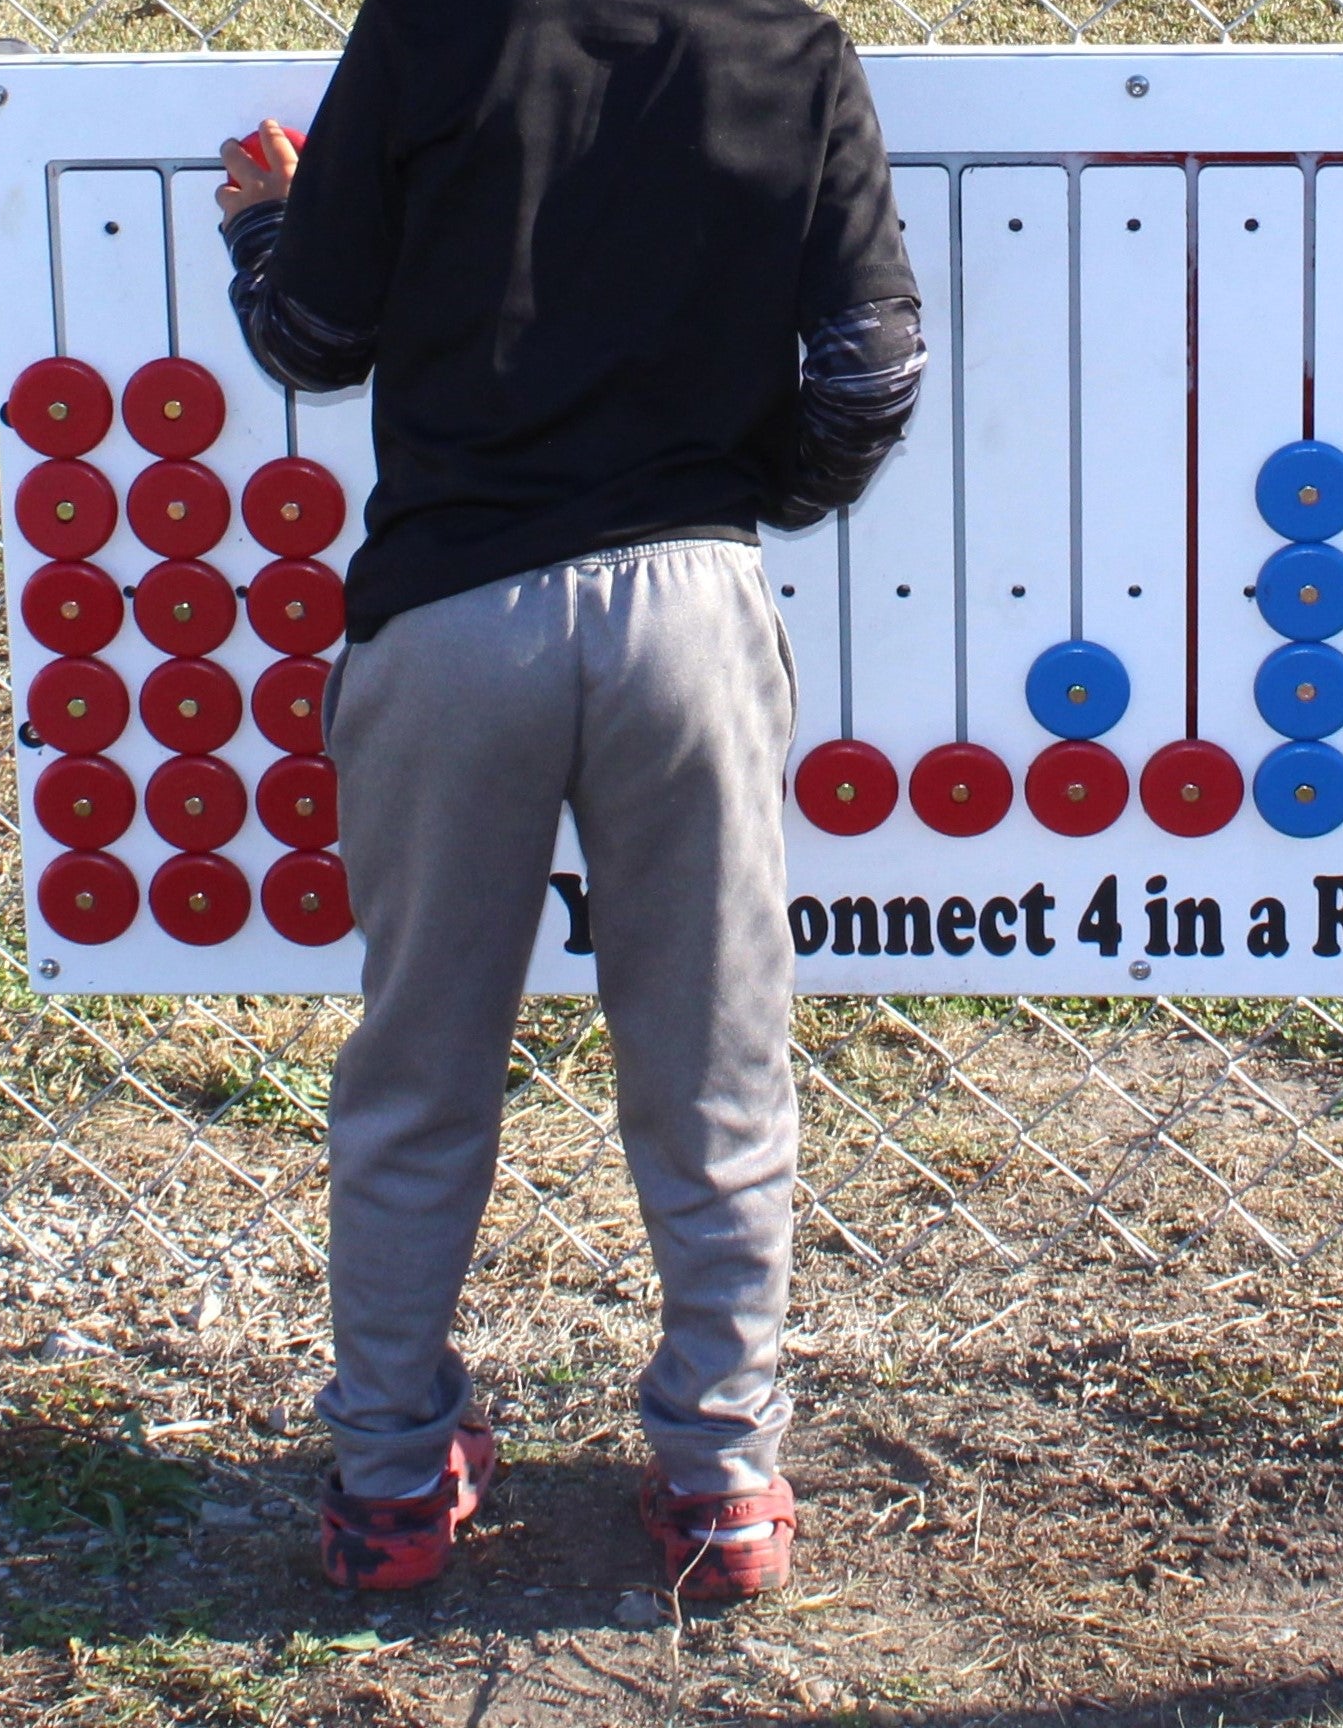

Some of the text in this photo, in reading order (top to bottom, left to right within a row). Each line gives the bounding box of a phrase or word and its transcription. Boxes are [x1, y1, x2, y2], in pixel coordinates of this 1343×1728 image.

[787, 881, 1055, 956] onnect
[1077, 873, 1122, 957] 4
[1144, 874, 1224, 957] in
[1247, 897, 1289, 957] a
